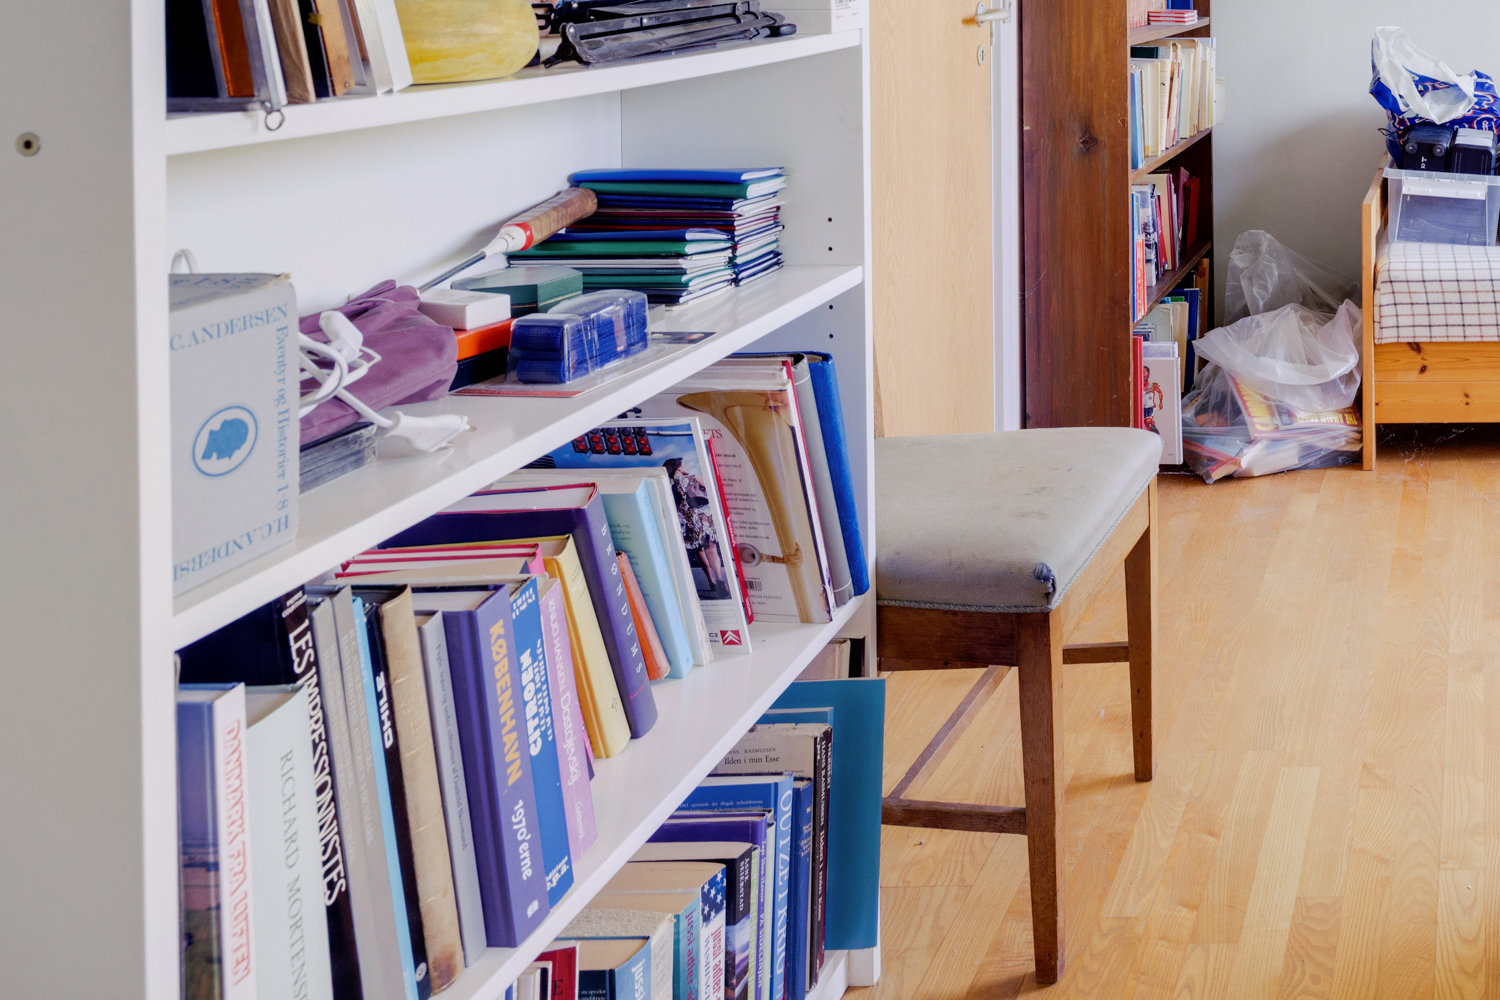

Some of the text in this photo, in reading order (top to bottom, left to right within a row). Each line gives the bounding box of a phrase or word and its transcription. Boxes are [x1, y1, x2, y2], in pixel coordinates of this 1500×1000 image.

[277, 407, 291, 481] Historier
[289, 619, 314, 674] LES
[490, 618, 523, 787] KØBENHAVN
[223, 719, 246, 845] DANMARK
[280, 748, 301, 870] RICHARD
[685, 908, 696, 947] jussi
